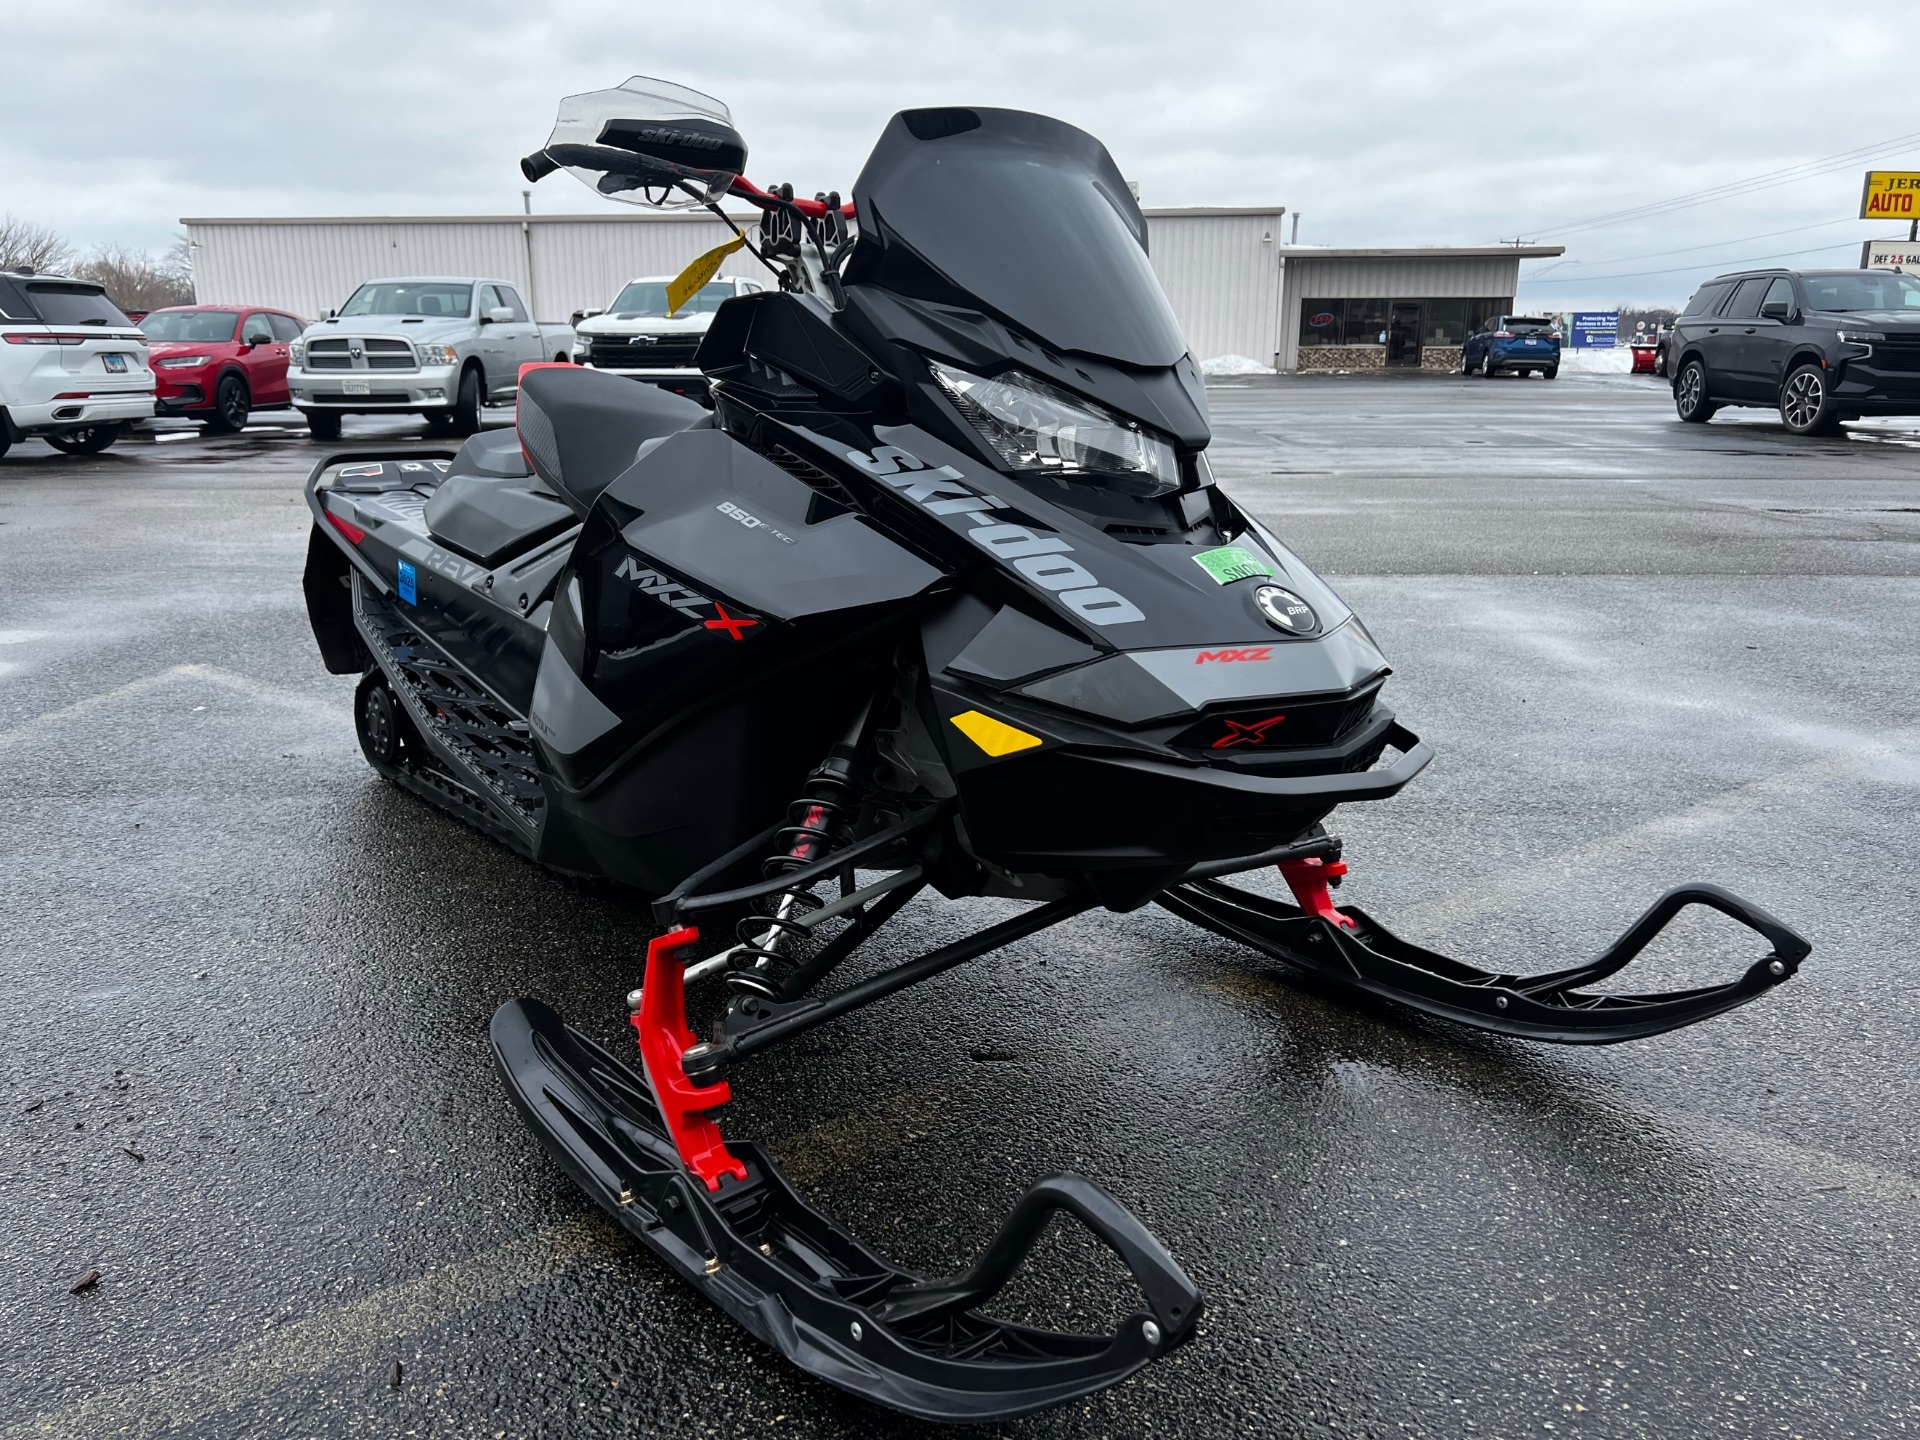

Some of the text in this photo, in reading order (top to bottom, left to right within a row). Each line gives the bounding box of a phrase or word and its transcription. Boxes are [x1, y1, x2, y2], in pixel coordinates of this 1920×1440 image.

[637, 128, 724, 150] ski-doo
[1868, 193, 1913, 212] AUTO
[1874, 255, 1888, 264] DEF
[1890, 255, 1904, 264] 2.5
[716, 501, 795, 544] 850 E-TEC
[847, 445, 1146, 626] ski-doo
[400, 572, 414, 589] 2025
[614, 556, 713, 619] MXZ
[704, 601, 758, 641] X
[1287, 606, 1309, 616] BRP
[1195, 648, 1275, 665] MXZ
[1212, 716, 1286, 748] X
